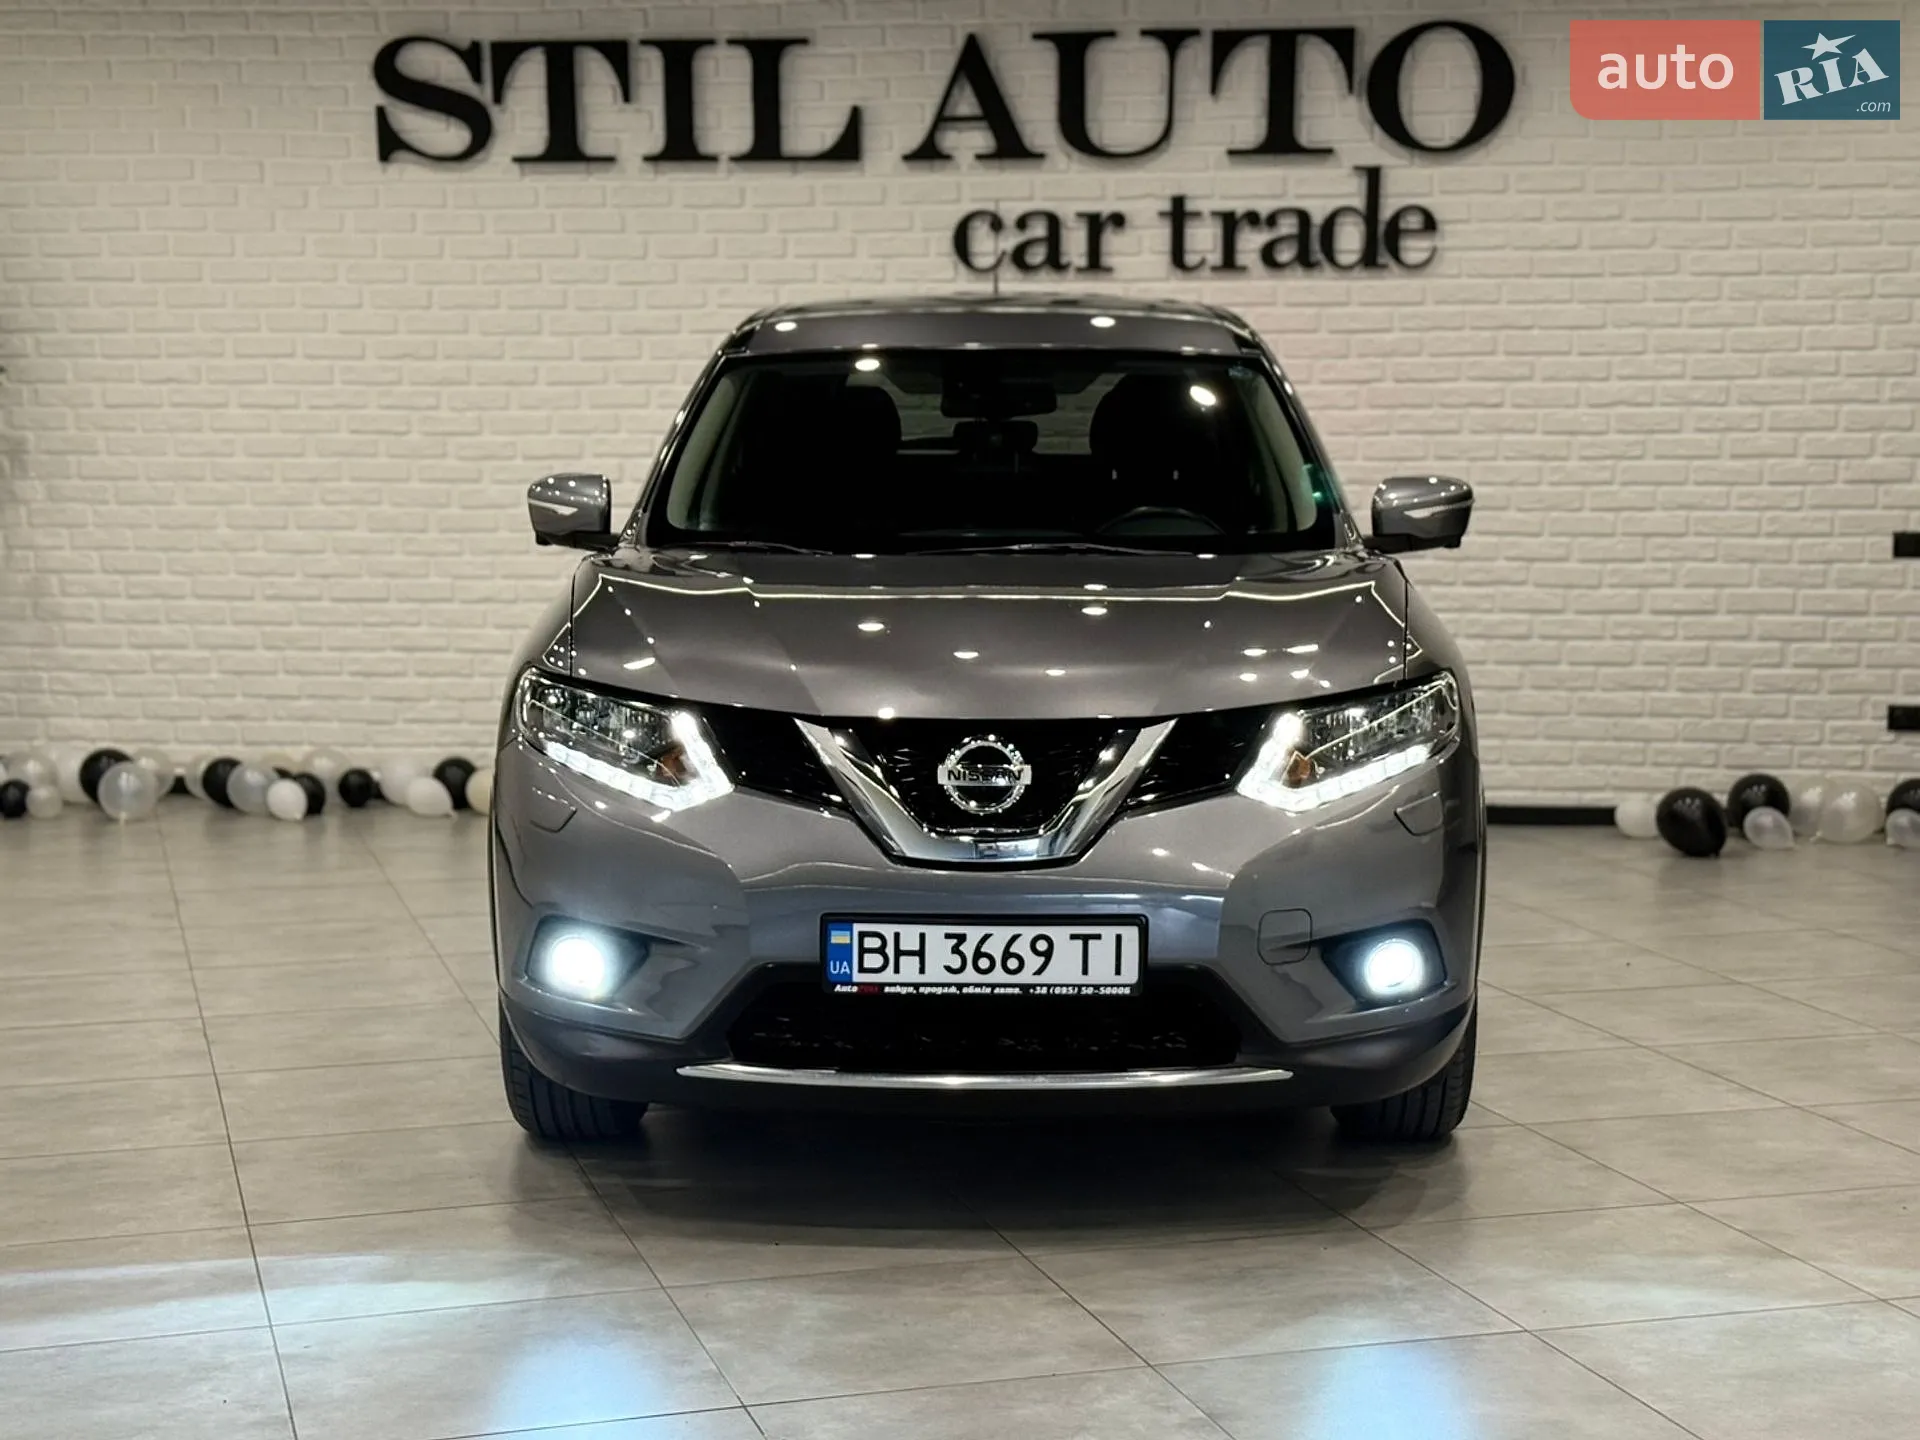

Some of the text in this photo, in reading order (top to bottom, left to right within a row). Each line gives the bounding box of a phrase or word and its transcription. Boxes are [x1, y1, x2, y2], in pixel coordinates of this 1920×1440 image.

[373, 20, 1516, 164] STIL AUTO
[953, 166, 1439, 273] car trade
[829, 960, 850, 975] UA
[857, 930, 1122, 976] BH 3669 TI
